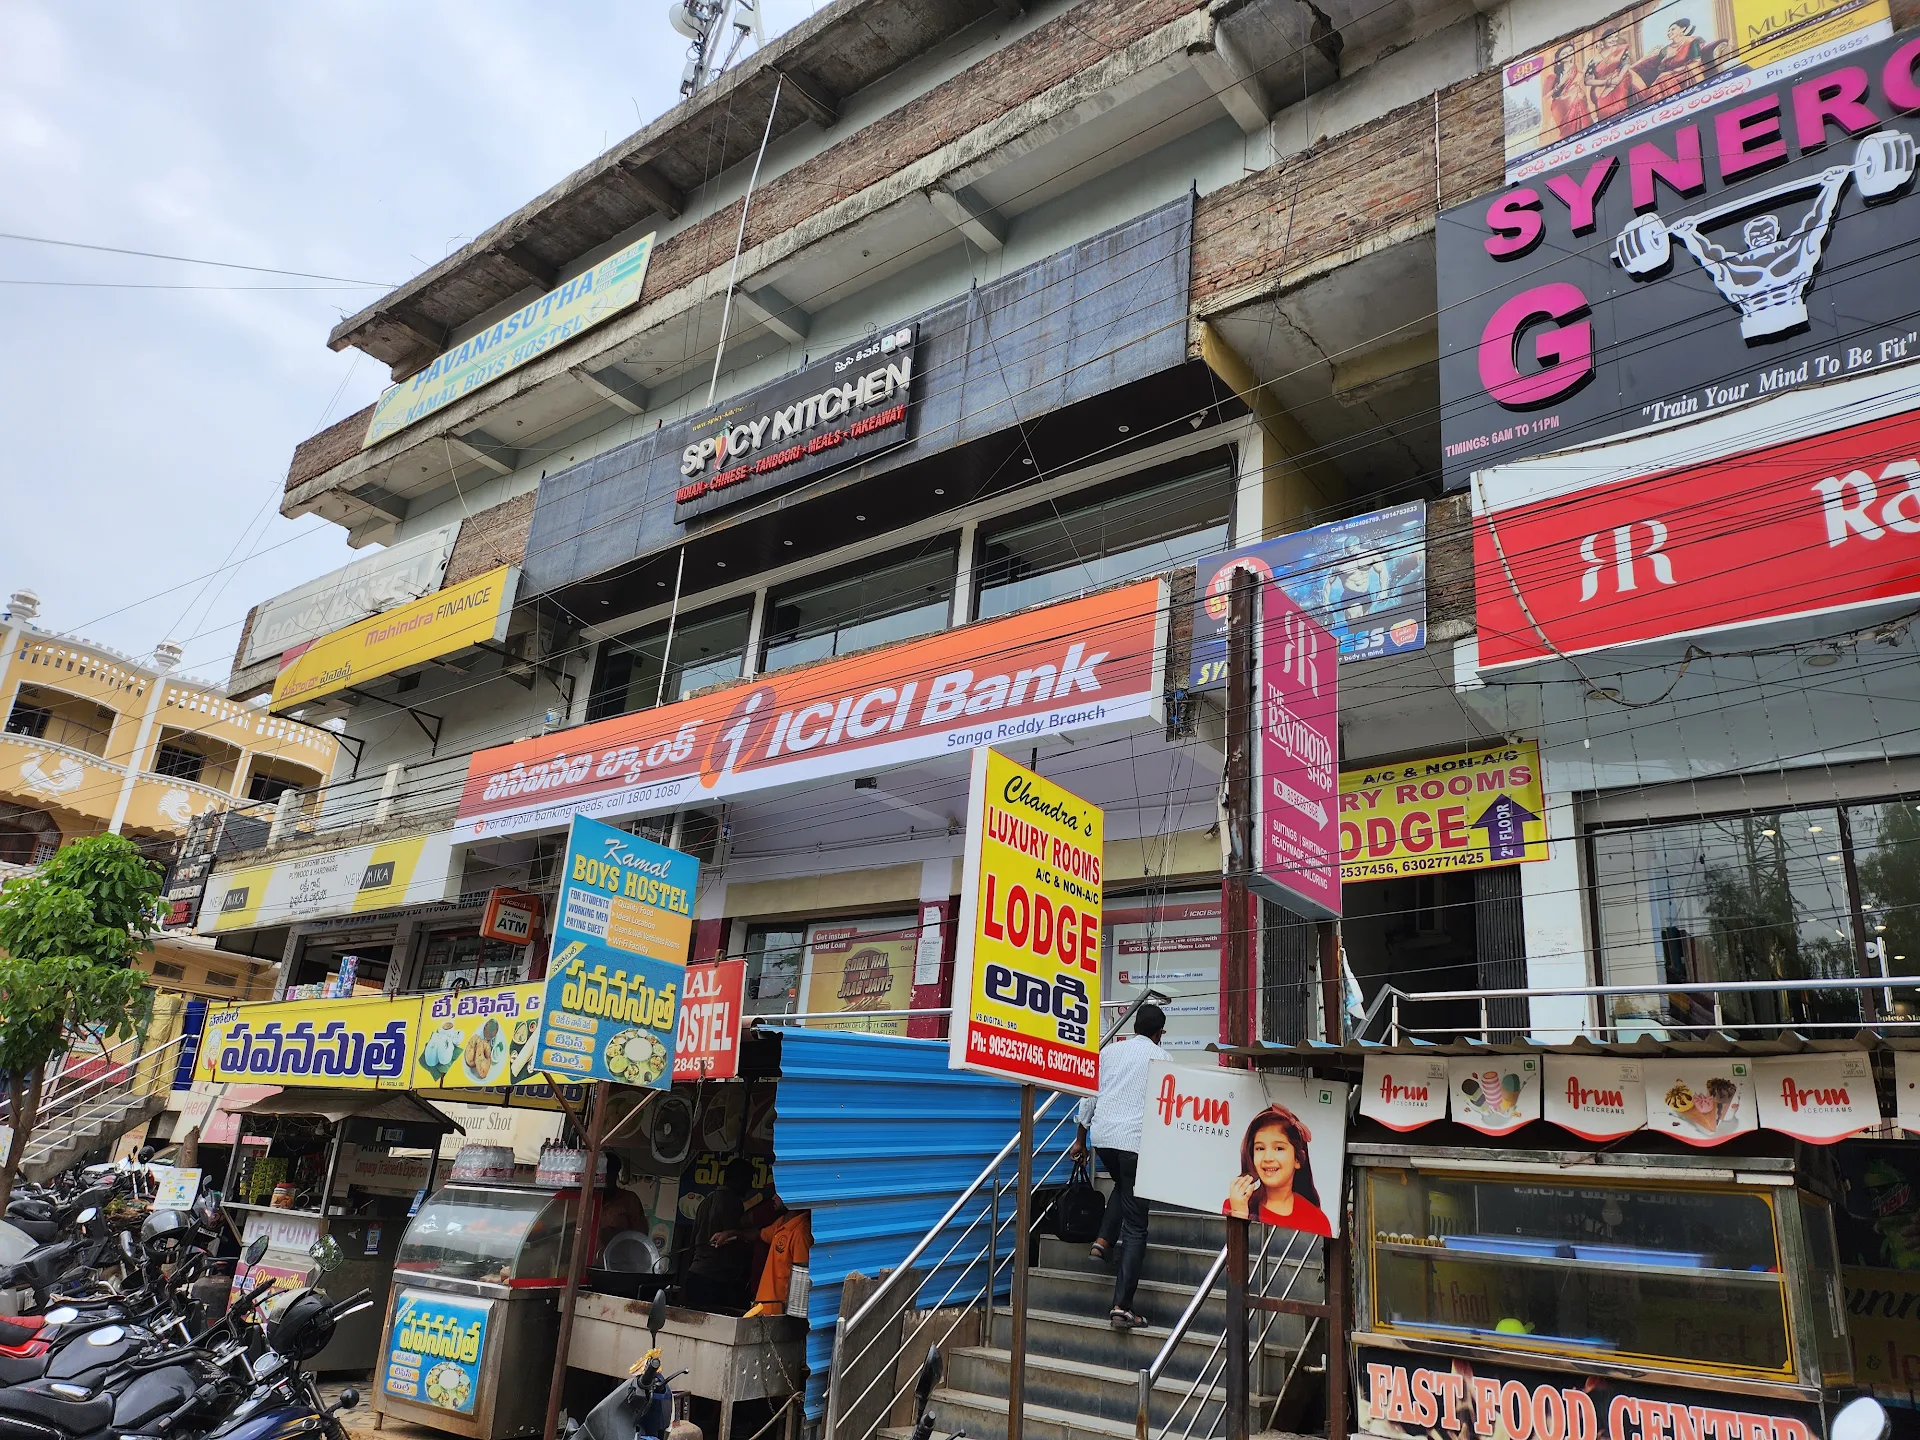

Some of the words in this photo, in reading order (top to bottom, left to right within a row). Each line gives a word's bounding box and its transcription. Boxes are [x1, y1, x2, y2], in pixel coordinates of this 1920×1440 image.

[1766, 68, 1783, 80] Ph
[1575, 143, 1587, 155] &
[412, 271, 593, 392] PAVANASUTHA
[405, 385, 458, 424] KAMAL
[462, 358, 506, 393] BOYS
[510, 313, 584, 367] HOSTEL
[1705, 381, 1749, 410] Your
[1760, 361, 1809, 393] Mind
[1815, 354, 1840, 379] To
[1847, 346, 1874, 370] Be
[680, 415, 771, 476] SPICY
[771, 356, 912, 440] KITCHEN
[709, 464, 748, 491] CHINESE
[755, 444, 802, 474] TANDOORI
[807, 429, 842, 454] MEALS
[849, 403, 906, 439] TAKEAWAY
[1445, 432, 1490, 458] TIMINGS:
[1491, 426, 1513, 444] 6AM
[1514, 422, 1530, 439] TO
[1532, 414, 1561, 436] 11PM
[1330, 525, 1345, 534] Cell:
[363, 611, 434, 648] Mahindra
[435, 586, 492, 622] FINANCE
[1343, 652, 1360, 662] body
[1367, 648, 1384, 657] mind
[767, 682, 919, 758] ICICI
[920, 643, 1110, 725] Bank
[1267, 681, 1284, 704] THE
[946, 723, 993, 747] Sanga
[997, 717, 1044, 743] Reddy
[1050, 704, 1107, 732] Branch
[596, 718, 705, 785] బ్యాంక్
[1362, 770, 1396, 785] A/C
[1403, 767, 1418, 778] &
[1425, 750, 1519, 775] NON-A/C
[1306, 763, 1333, 793] SHOP
[1396, 765, 1533, 805] ROOMS
[512, 814, 534, 830] your
[535, 804, 572, 824] banking
[574, 798, 605, 815] needs,
[606, 794, 625, 807] call
[626, 788, 652, 804] 1800
[654, 783, 681, 799] 1080
[1002, 774, 1093, 838] Chandra's
[1496, 803, 1514, 841] FLOOR
[987, 805, 1049, 863] LUXURY
[1051, 835, 1101, 887] ROOMS
[1272, 819, 1298, 842] SUITINGS
[1301, 836, 1328, 861] SHIRTINGS
[1340, 804, 1469, 862] ODGE
[603, 837, 672, 880] Kamal
[1271, 833, 1305, 860] READYMADE
[1304, 854, 1332, 877] GARMENTS
[1276, 851, 1283, 864] IN
[1302, 866, 1328, 890] TAILORING
[1402, 852, 1485, 872] 6302771425
[343, 872, 364, 888] NEW
[364, 866, 391, 884] MIKA
[572, 852, 621, 894] BOYS
[623, 870, 690, 916] HOSTEL
[1035, 867, 1051, 885] A/C
[1053, 875, 1061, 889] &
[1062, 880, 1100, 906] NON-A/C
[568, 903, 595, 920] WORKING
[595, 910, 609, 924] MEN
[570, 889, 582, 900] FOR
[582, 892, 610, 910] STUDENTS
[617, 899, 640, 914] Quality
[639, 905, 655, 918] Food
[496, 917, 528, 934] ATM
[565, 916, 587, 930] PAYING
[586, 919, 605, 936] GUEST
[616, 912, 631, 924] Ideal
[630, 915, 656, 931] Location
[816, 931, 829, 941] Get
[828, 931, 851, 941] instant
[983, 873, 1098, 975] LODGE
[612, 936, 630, 947] Wi-Fi
[629, 940, 650, 956] Facility
[830, 941, 846, 949] Loan
[870, 952, 889, 968] HAI
[525, 996, 541, 1010] &
[837, 981, 863, 998] JAAG
[984, 963, 1089, 1045] లాడ్జి
[1180, 1005, 1200, 1013] approved
[1199, 1004, 1216, 1013] projects
[676, 1001, 733, 1054] OSTEL
[970, 1029, 987, 1053] Ph:
[988, 1033, 1046, 1070] 9052537456,
[1047, 1048, 1096, 1079] 6302771425
[1156, 1073, 1231, 1127] Arun
[1380, 1074, 1429, 1104] Arun
[1393, 1100, 1429, 1108] ICECREAMS
[1564, 1076, 1624, 1110] Arun
[1780, 1077, 1851, 1112] Arun
[183, 1100, 208, 1116] Hero
[486, 1112, 513, 1131] Shot
[1583, 1106, 1626, 1115] ICECREAMS
[1803, 1106, 1854, 1114] ICECREAMS
[1176, 1122, 1231, 1139] ICECREAMS
[355, 1159, 378, 1177] Company
[248, 1221, 273, 1242] TEA
[1366, 1362, 1465, 1432] FAST
[1473, 1376, 1598, 1440] FOOD
